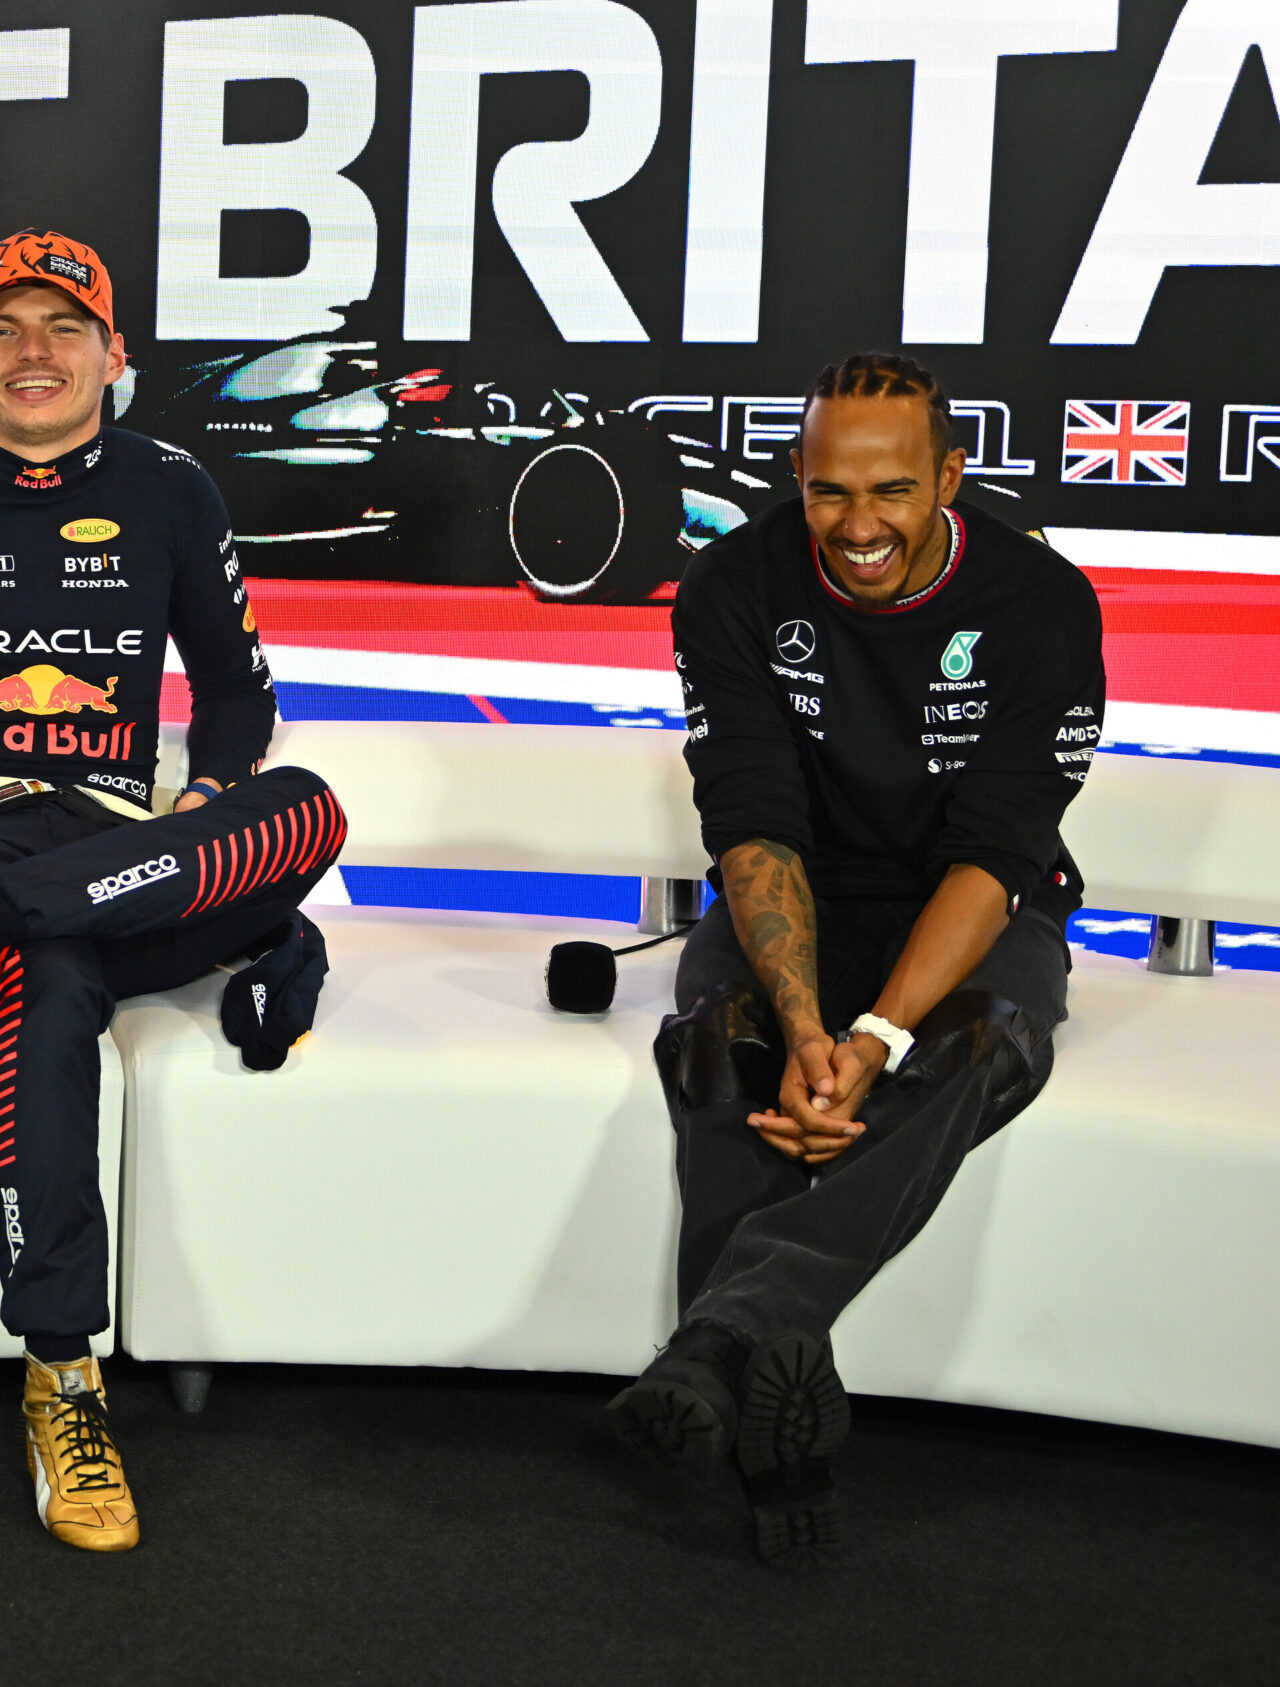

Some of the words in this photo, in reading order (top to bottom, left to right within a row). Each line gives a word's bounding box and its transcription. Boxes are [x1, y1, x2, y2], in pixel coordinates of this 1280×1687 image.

[14, 475, 39, 489] Red
[40, 475, 62, 489] Bull
[76, 525, 113, 537] RAUCH
[64, 553, 121, 573] BYBIT
[61, 579, 129, 588] HONDA
[929, 680, 987, 692] PETRONAS
[923, 700, 989, 724] INEOS
[47, 722, 137, 761] Bull
[1055, 727, 1086, 742] AMD
[86, 854, 181, 905] sparco
